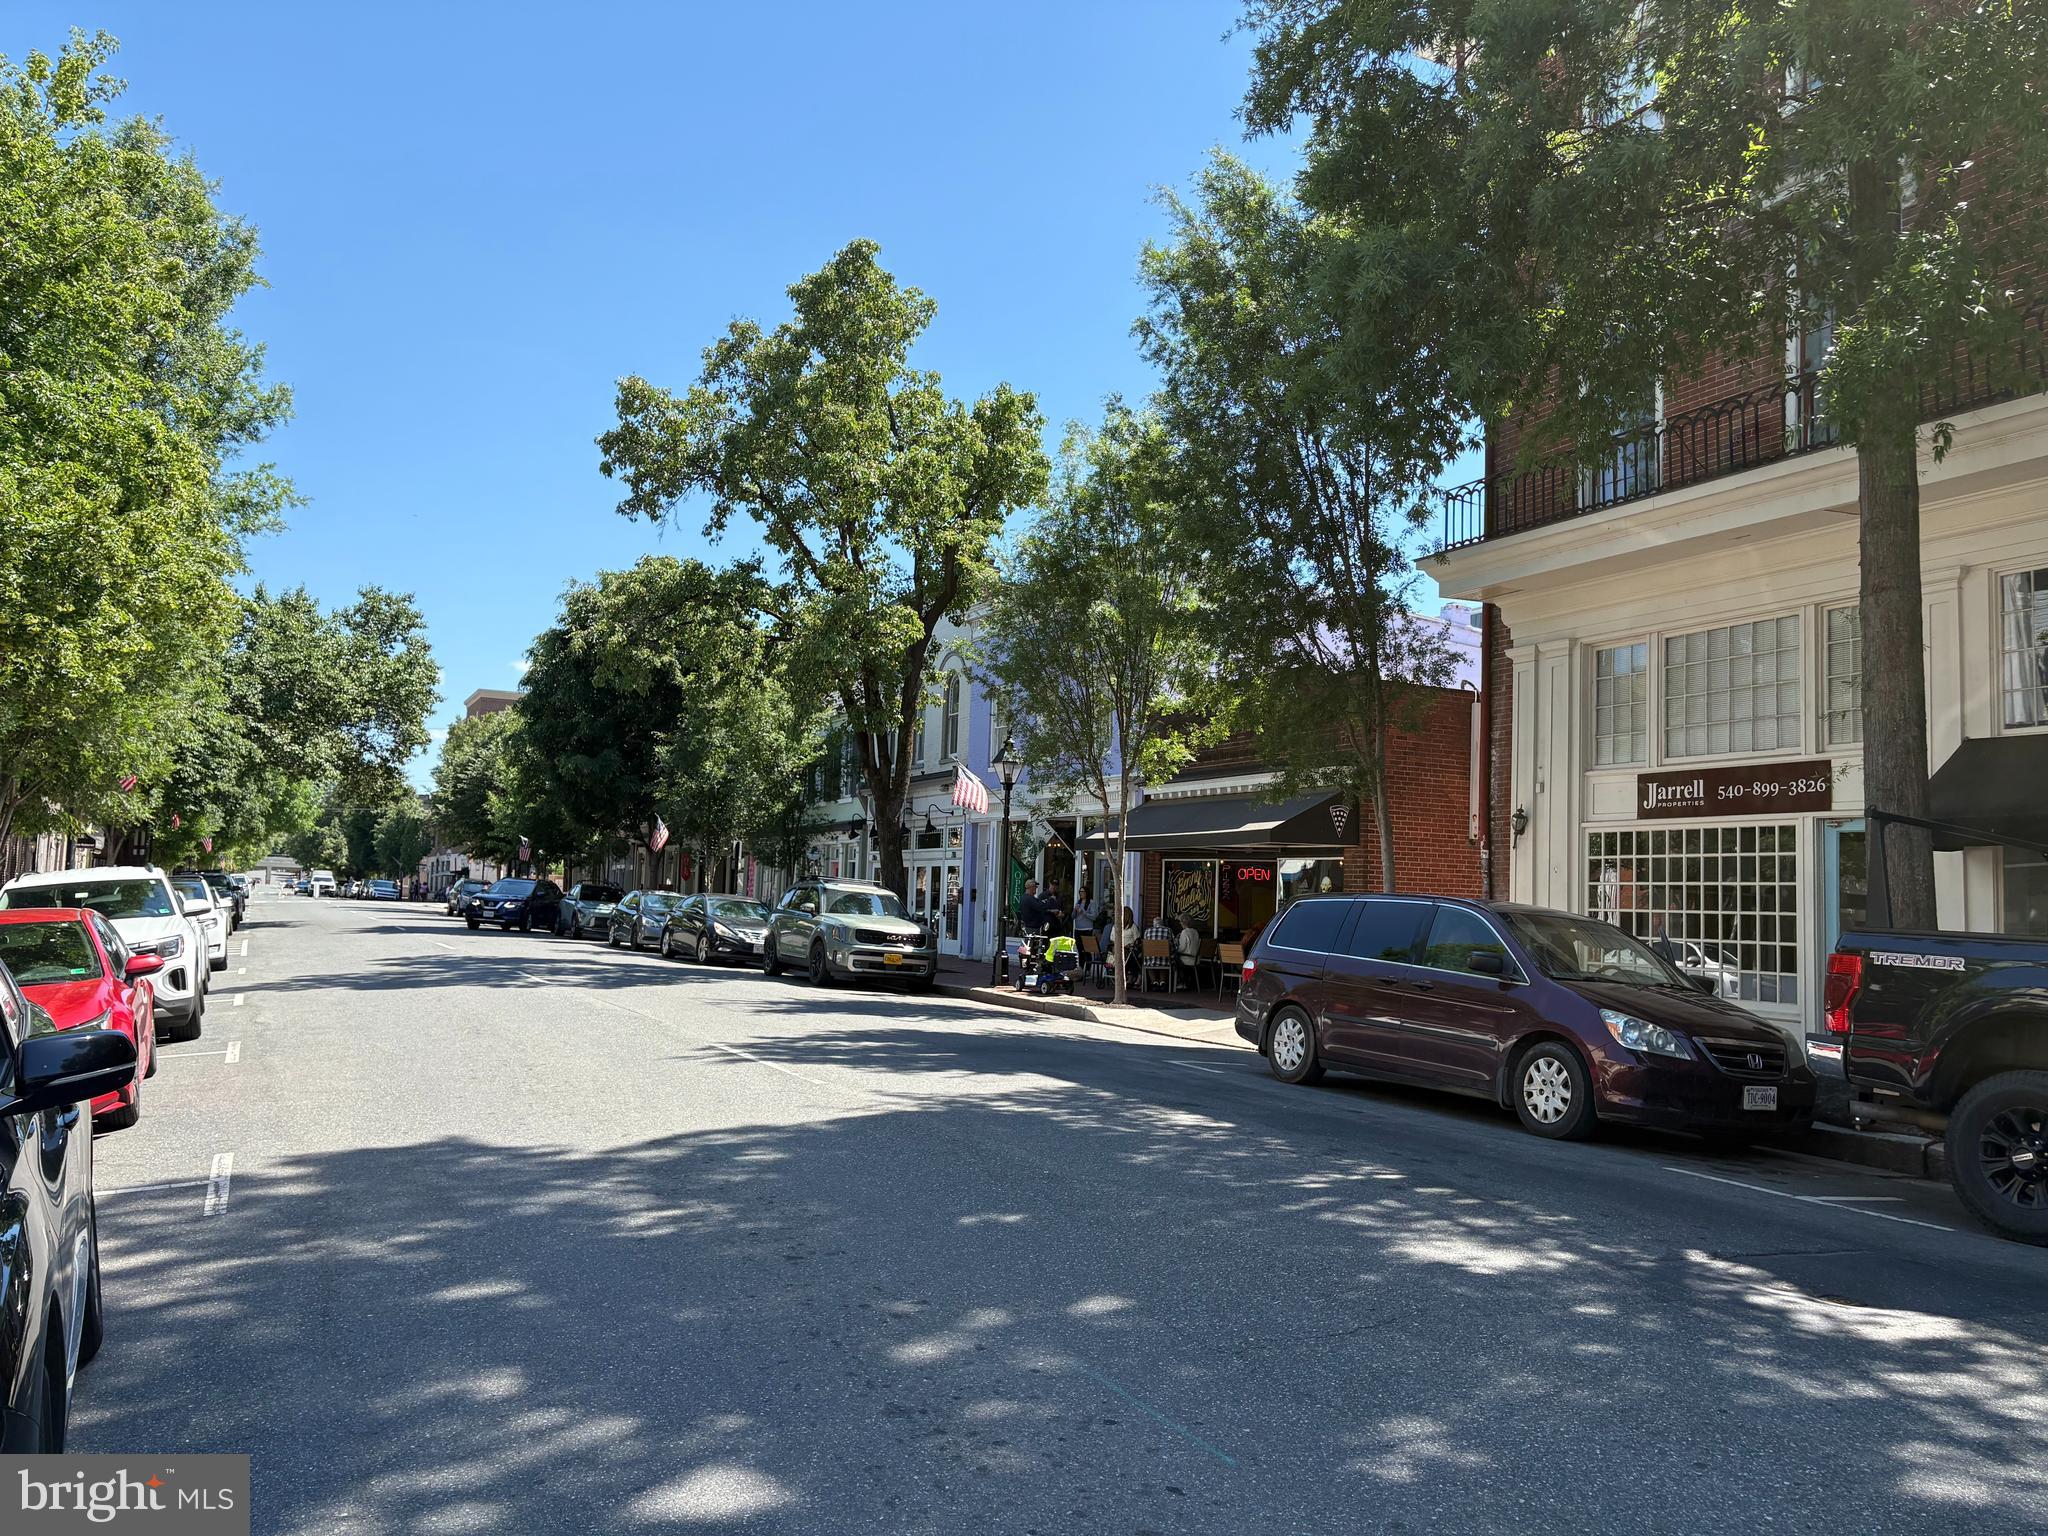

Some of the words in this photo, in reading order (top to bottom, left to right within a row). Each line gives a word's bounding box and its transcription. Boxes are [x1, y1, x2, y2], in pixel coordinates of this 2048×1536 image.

[1643, 779, 1705, 809] Jarrell
[1717, 777, 1826, 800] 540-899-3826
[1657, 800, 1704, 808] PROPERTIES
[1238, 868, 1270, 881] OPEN
[1013, 871, 1022, 904] OPEN
[1869, 951, 1967, 972] TREMOR
